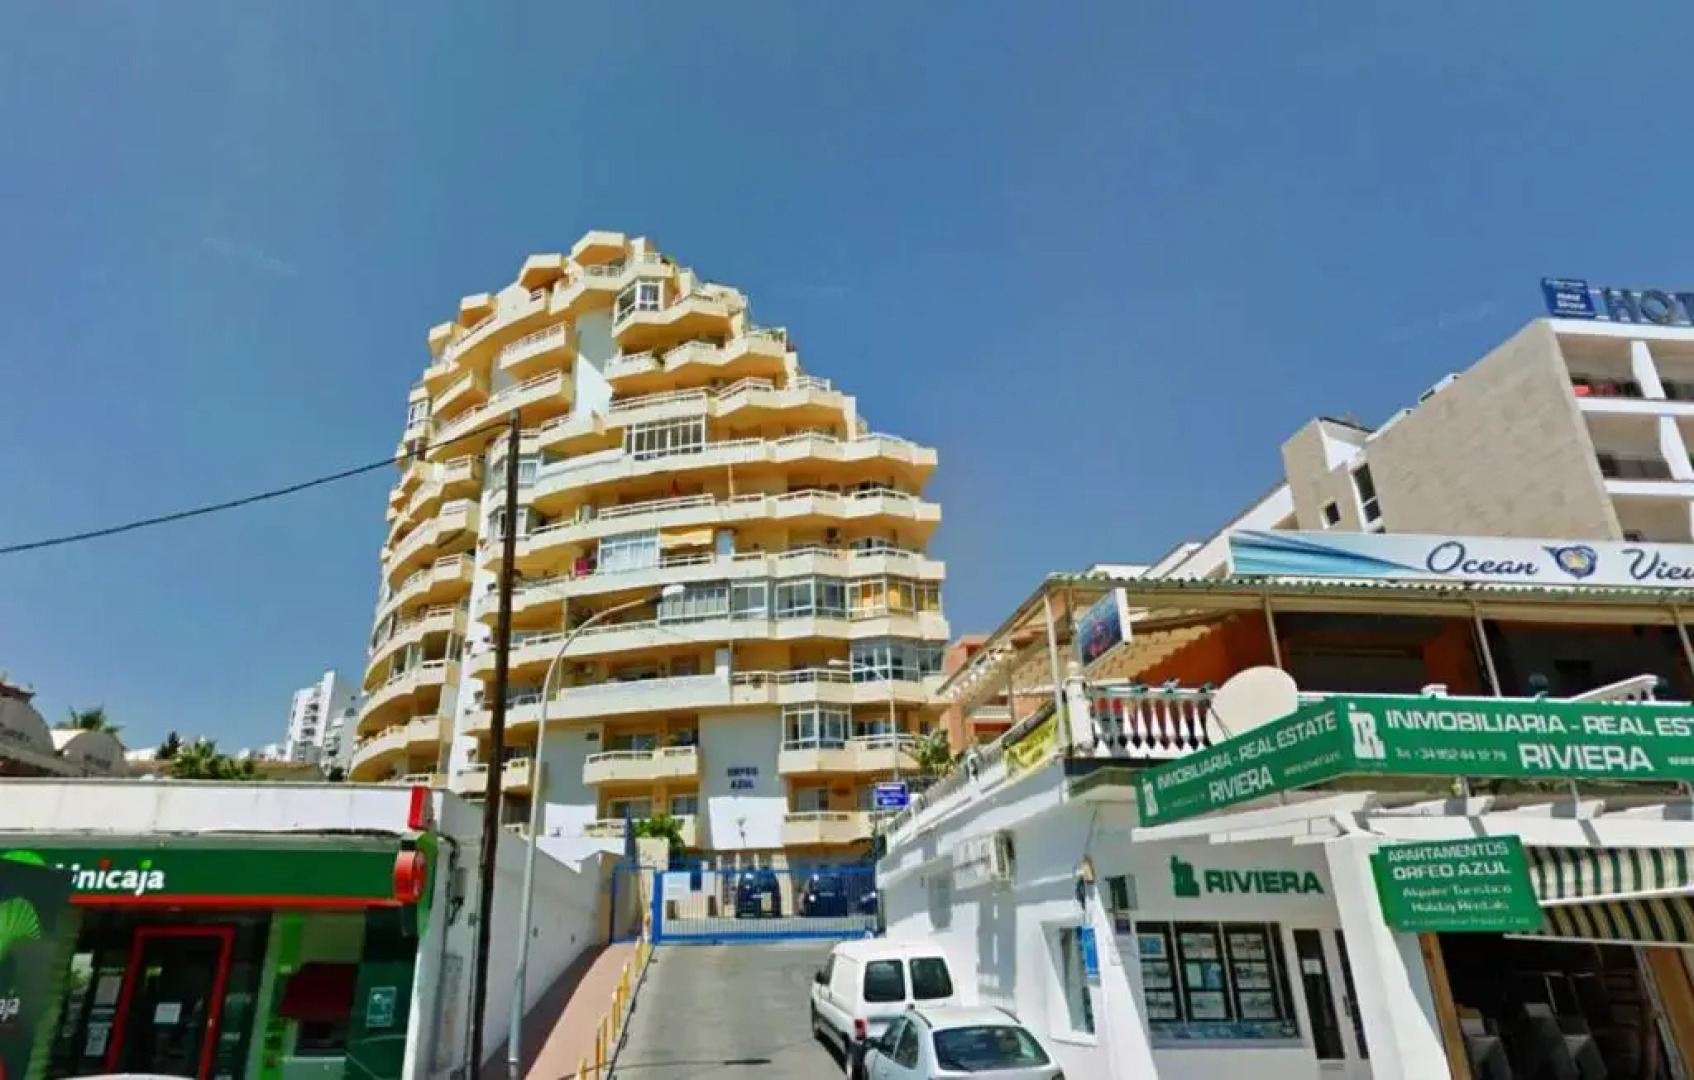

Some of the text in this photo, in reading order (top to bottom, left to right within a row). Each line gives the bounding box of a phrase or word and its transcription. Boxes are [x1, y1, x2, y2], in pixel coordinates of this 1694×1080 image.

[1426, 541, 1539, 575] Ocean
[1385, 709, 1567, 734] INMOBILIARIA
[1582, 715, 1654, 735] REAL
[1238, 736, 1276, 762] REAL
[1277, 711, 1337, 748] ESTATE
[1518, 743, 1655, 772] RIVIERA
[1208, 765, 1273, 804] RIVIERA
[1388, 842, 1509, 862] APARTAMENTOS
[1204, 869, 1325, 894] RIVIERA
[1393, 859, 1512, 880] ORFEO AZUL
